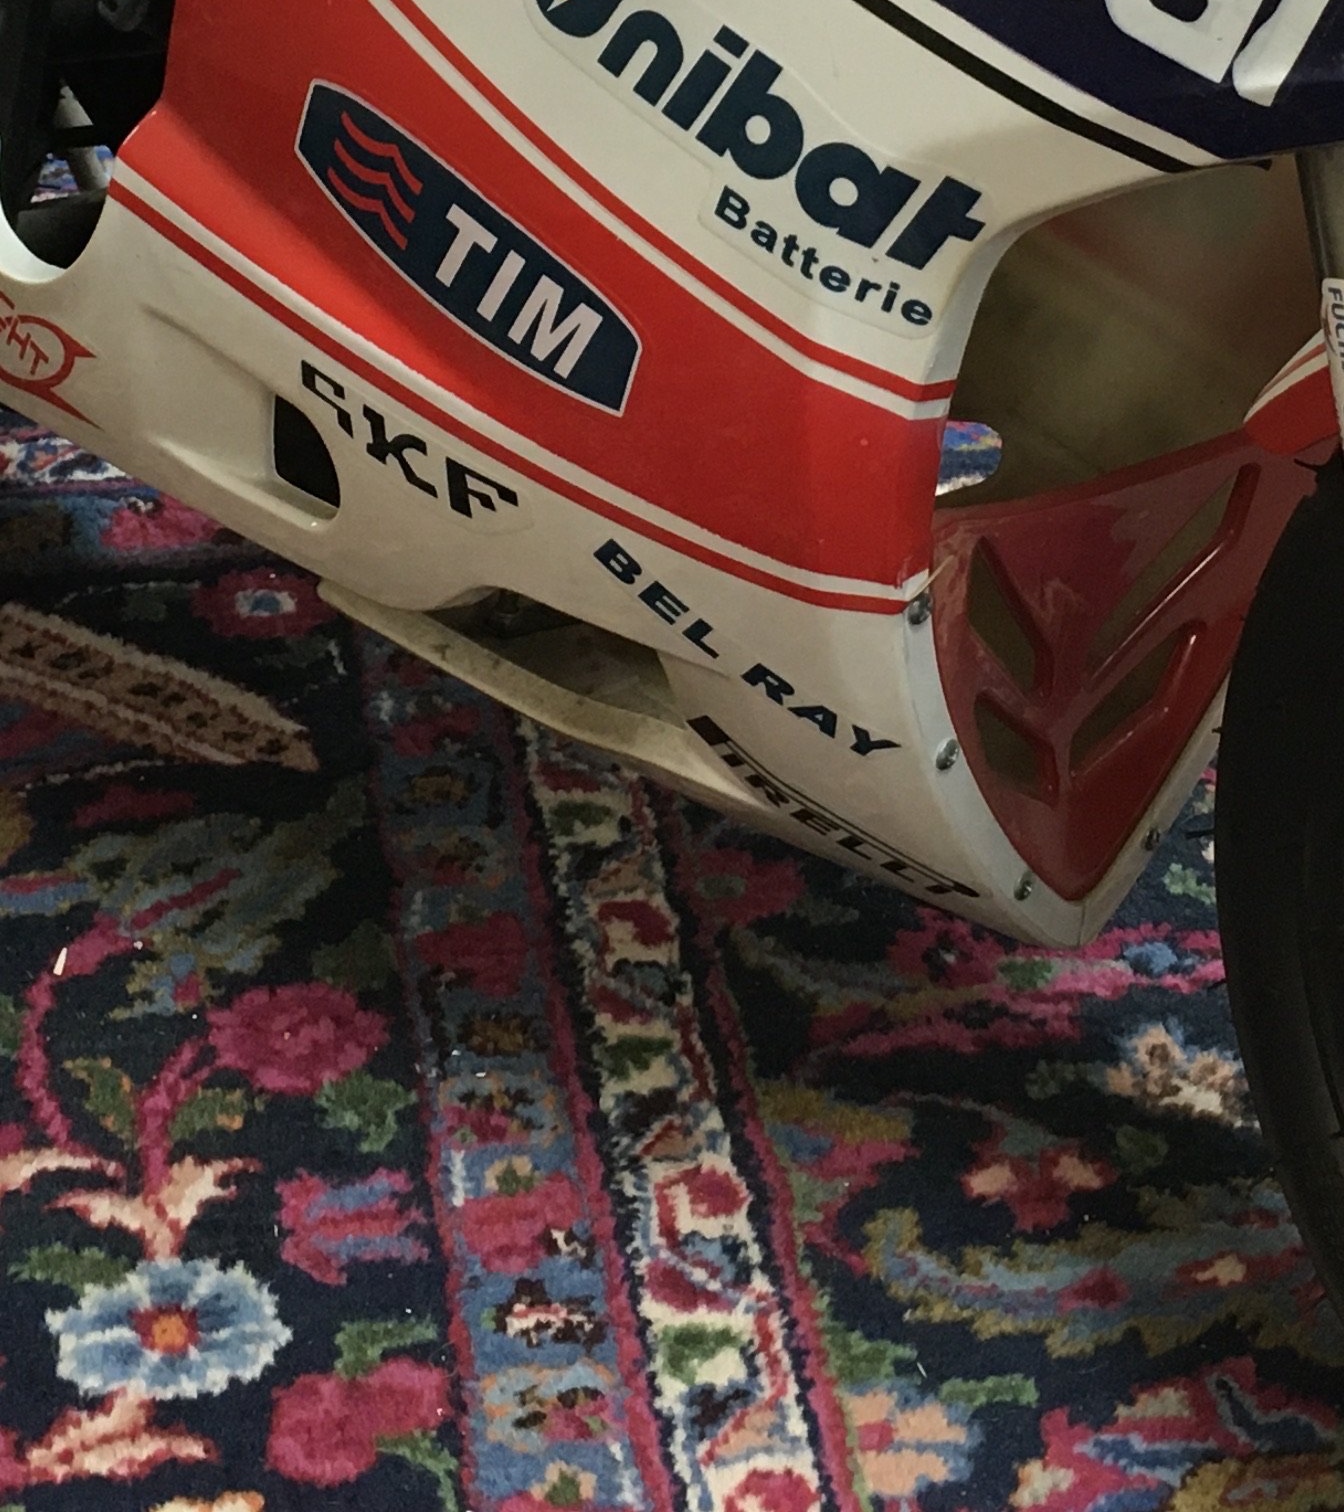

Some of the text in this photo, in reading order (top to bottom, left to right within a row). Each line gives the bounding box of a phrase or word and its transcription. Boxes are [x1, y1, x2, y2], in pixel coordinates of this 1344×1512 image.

[437, 206, 603, 380] TIM
[712, 188, 935, 329] Batterie
[300, 359, 519, 519] SKF
[593, 539, 902, 757] BEL RAY
